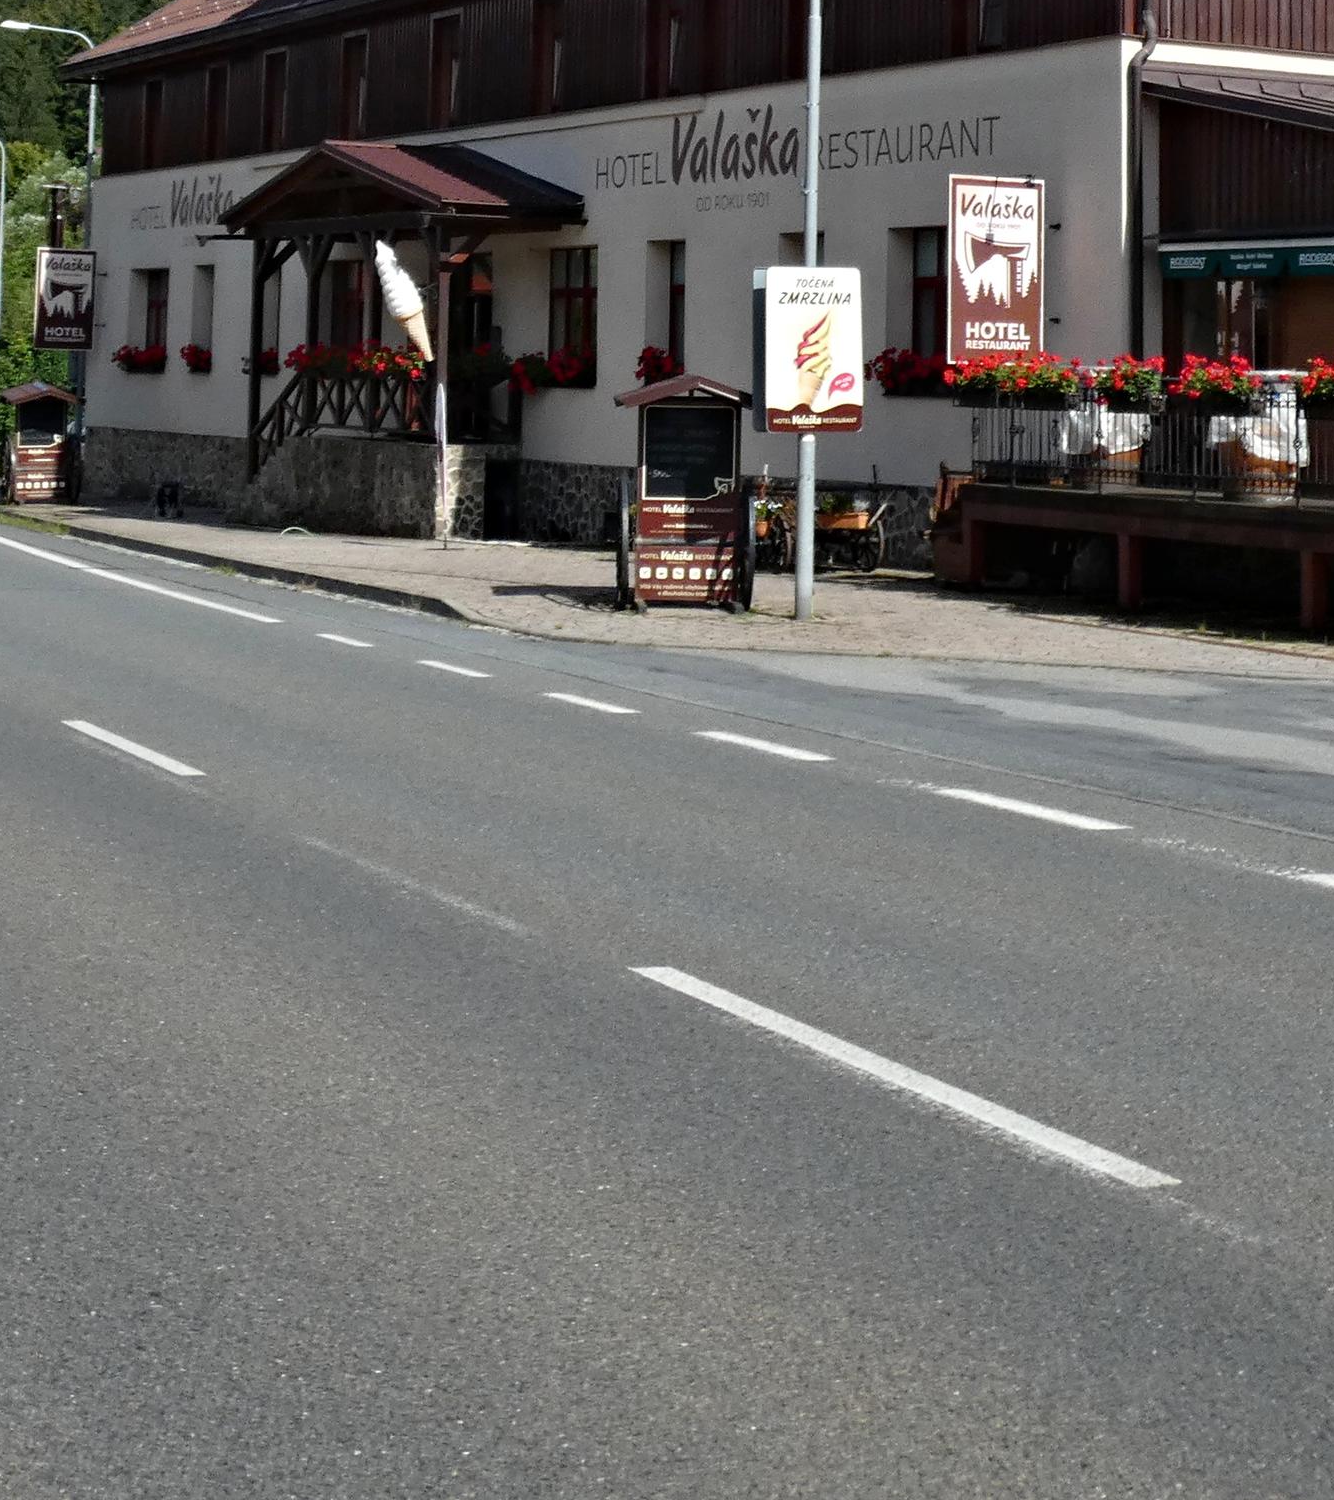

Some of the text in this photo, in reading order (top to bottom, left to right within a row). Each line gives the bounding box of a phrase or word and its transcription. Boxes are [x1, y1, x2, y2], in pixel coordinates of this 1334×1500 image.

[595, 151, 666, 190] HOTEL
[671, 103, 800, 186] Valaška
[960, 192, 1035, 221] Valaška
[795, 276, 834, 289] TOČENÁ
[778, 291, 851, 305] ZMRZLINA
[44, 326, 86, 337] HOTEL
[965, 321, 1031, 341] HOTEL
[965, 340, 1031, 351] RESTAURANT
[792, 414, 822, 426] Valaška
[660, 550, 694, 561] Valaška
